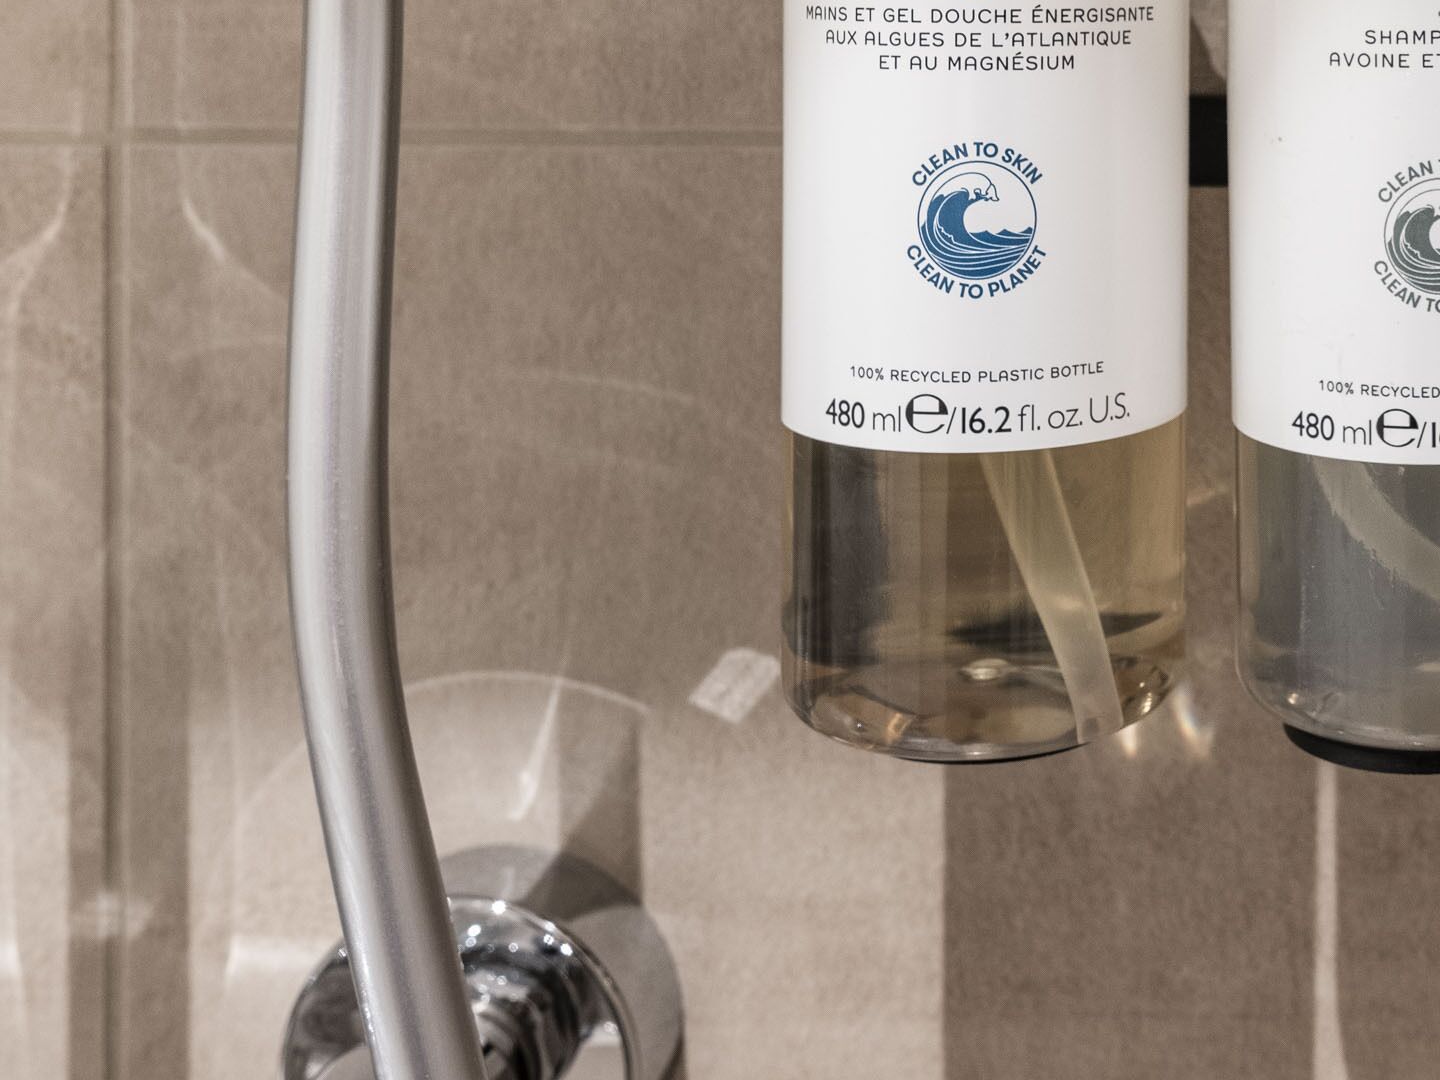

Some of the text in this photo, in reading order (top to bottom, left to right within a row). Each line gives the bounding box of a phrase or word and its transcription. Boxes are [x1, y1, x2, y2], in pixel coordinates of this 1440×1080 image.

[806, 5, 1154, 24] MAINS ET GEL DOUCHE ÉNERGISANTE
[826, 29, 857, 46] AUX
[864, 31, 944, 47] ALGUES
[954, 32, 982, 48] DE
[879, 52, 1075, 71] ET AU MAGNÉSIUM
[1329, 52, 1410, 68] AVOINE
[911, 141, 1043, 186] CLEAN TO SKIN
[1377, 160, 1434, 203] CLEAN
[906, 244, 1047, 299] CLEAN TO PLANET
[1373, 260, 1421, 309] CLEAN
[850, 361, 1104, 383] 100% RECYCLED PLASTIC BOTTLE
[1318, 379, 1354, 395] 100%
[1360, 384, 1440, 399] RECYCLED
[825, 398, 865, 428] 480
[1018, 404, 1041, 432] fl.
[1047, 405, 1083, 429] oz.
[1089, 392, 1131, 424] U.S.
[1291, 410, 1335, 441] 480
